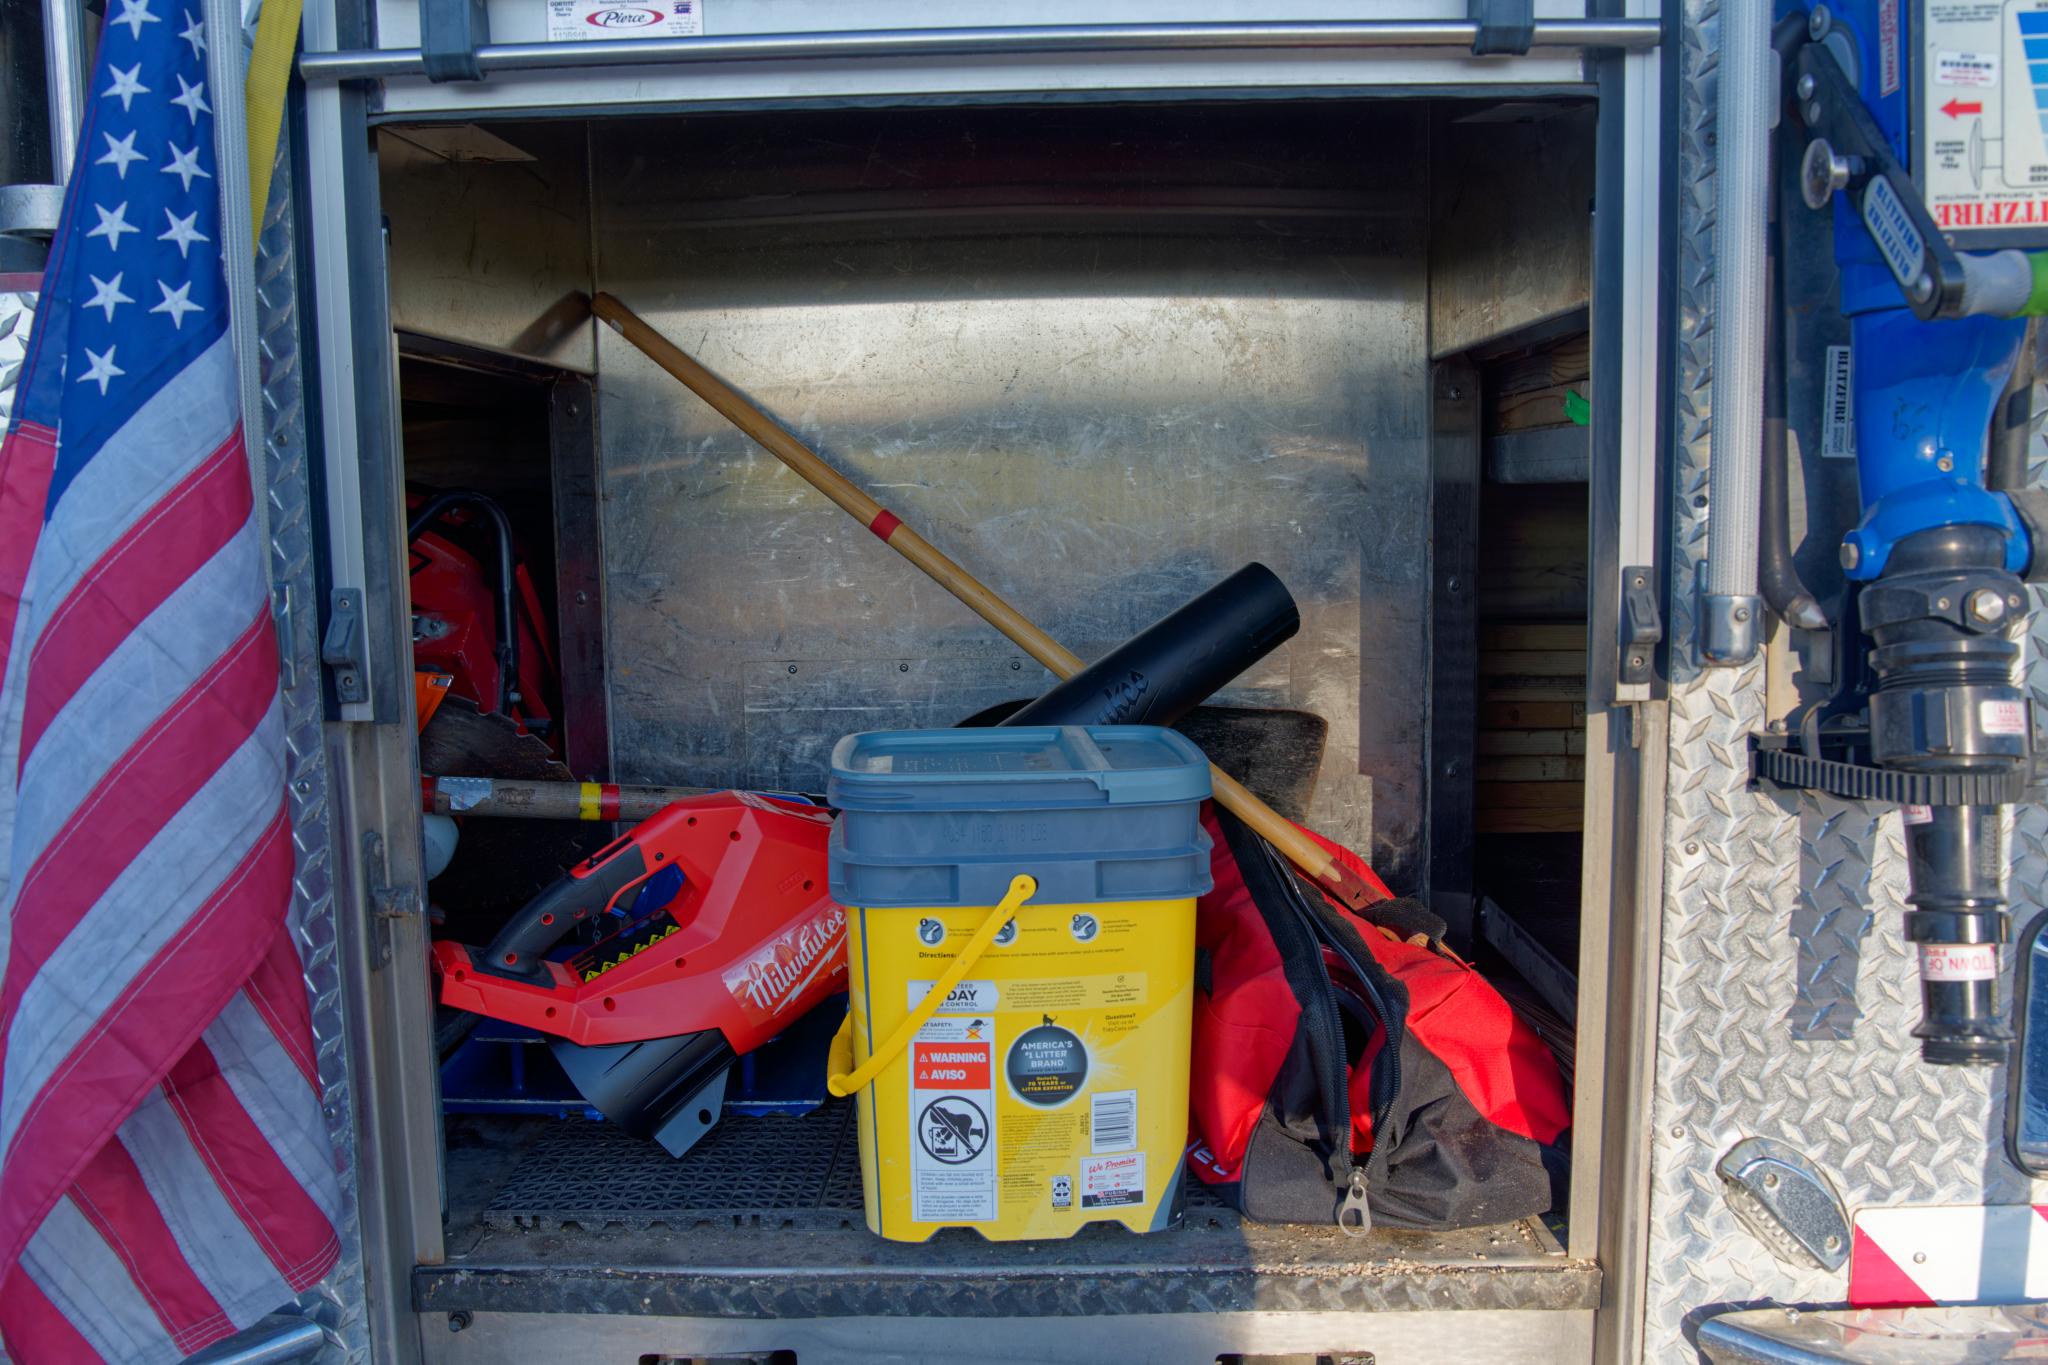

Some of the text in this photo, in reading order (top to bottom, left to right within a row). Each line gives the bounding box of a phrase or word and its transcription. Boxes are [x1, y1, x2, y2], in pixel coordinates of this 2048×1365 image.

[603, 11, 646, 26] Pierce
[1834, 350, 1849, 424] BLITZFIRE
[745, 910, 847, 1009] Milwaukee
[1021, 1040, 1073, 1050] AMERICA'S
[930, 1053, 987, 1063] WARNING
[1035, 1050, 1068, 1059] LITTER
[1031, 1059, 1064, 1068] BRAND
[931, 1070, 966, 1080] AVISO
[1105, 1157, 1136, 1170] Promise
